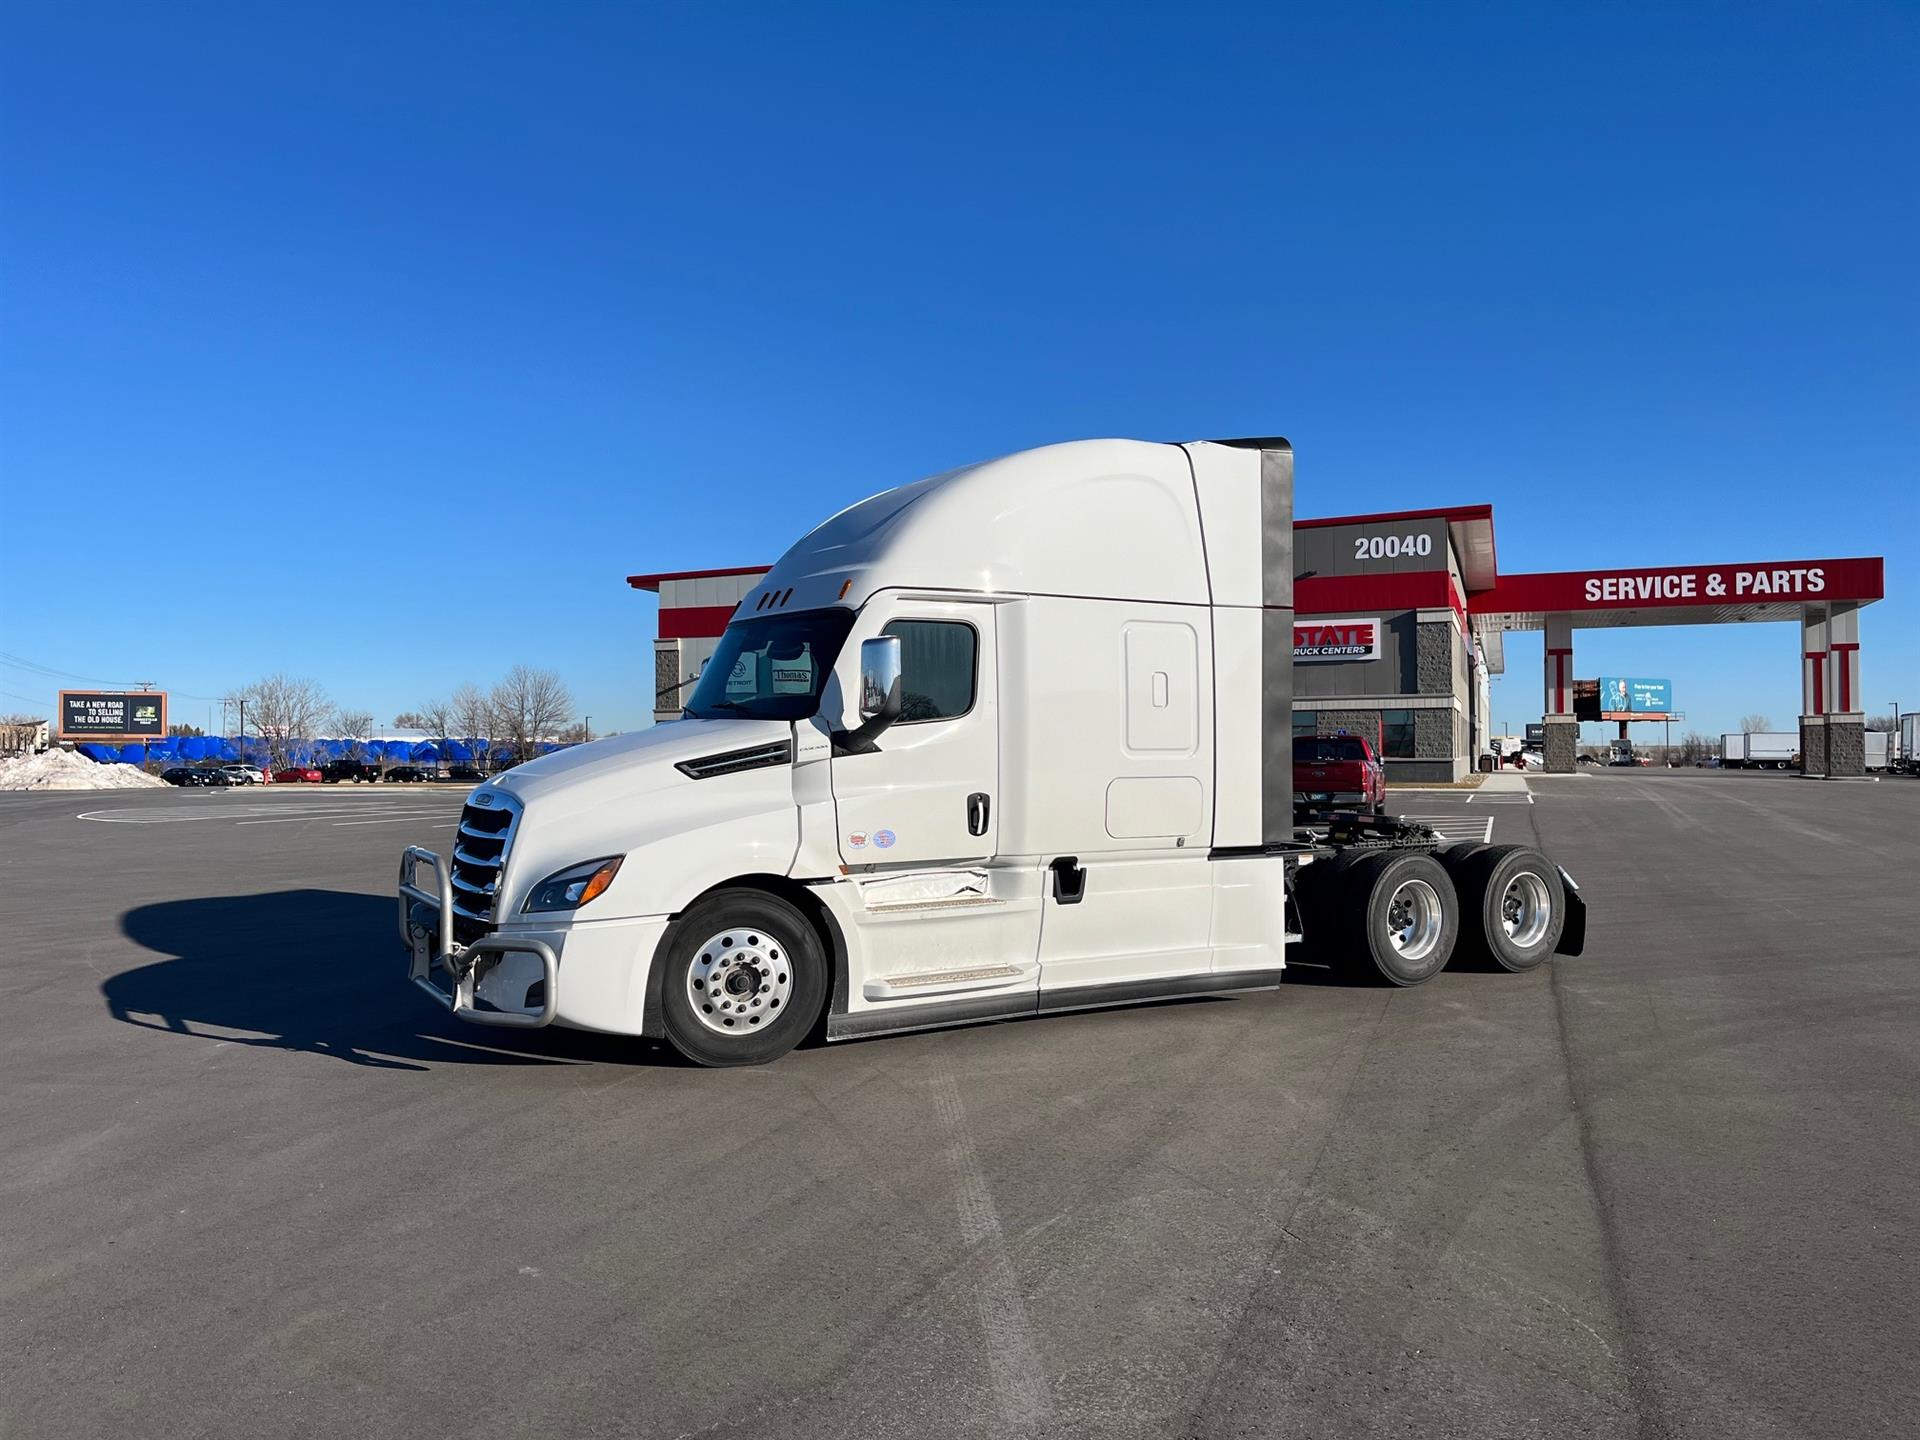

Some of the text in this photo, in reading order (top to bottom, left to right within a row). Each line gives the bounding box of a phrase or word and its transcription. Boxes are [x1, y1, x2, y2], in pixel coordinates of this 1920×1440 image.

[1354, 533, 1432, 560] 20040
[1585, 568, 1825, 602] SERVICE & PARTS
[1293, 646, 1366, 656] RUCK CENTERS
[776, 671, 808, 680] Thomas
[74, 715, 86, 723] THE
